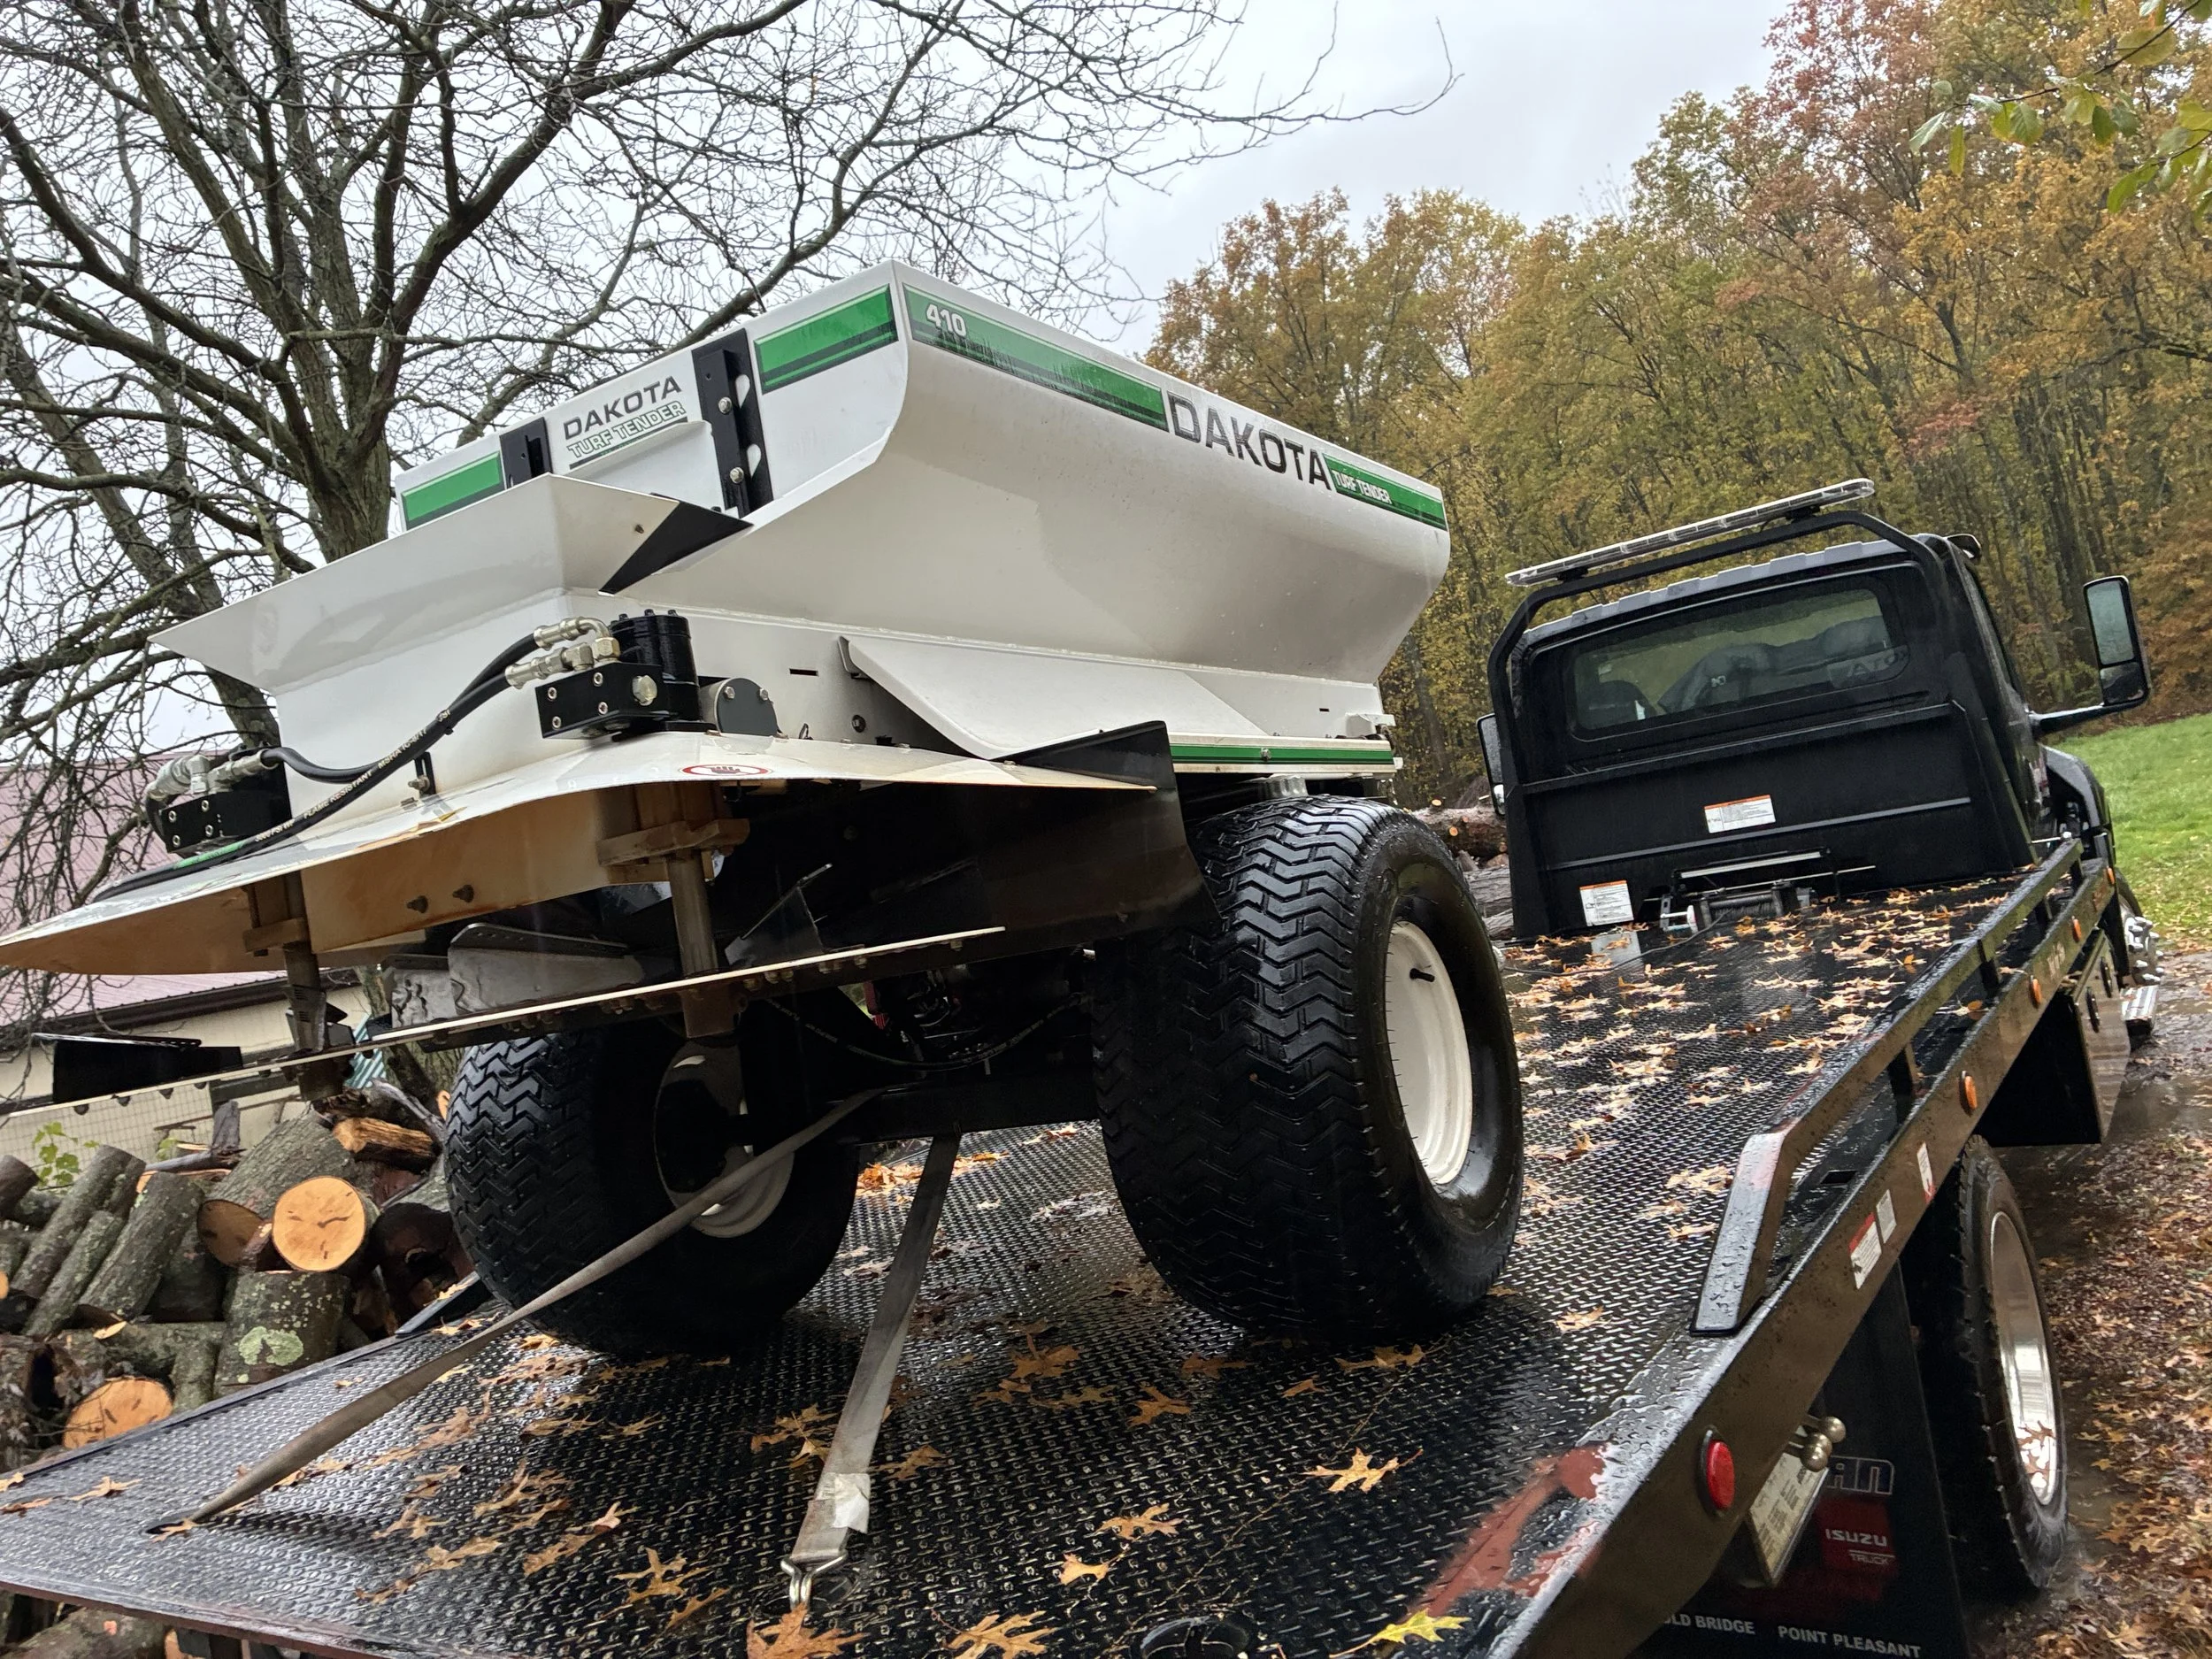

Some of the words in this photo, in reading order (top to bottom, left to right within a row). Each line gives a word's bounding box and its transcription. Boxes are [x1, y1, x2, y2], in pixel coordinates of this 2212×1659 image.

[926, 303, 966, 337] 410
[563, 375, 682, 441] DAKOTA
[566, 429, 613, 458] TURF
[611, 400, 687, 440] TENDER
[1167, 390, 1332, 491] DAKOTA
[1331, 470, 1356, 491] TURF
[1356, 479, 1393, 504] TENDER
[330, 771, 372, 803] RESISTANT
[1825, 1528, 1887, 1547] ISUZU
[1849, 1553, 1889, 1565] TRUCK
[1695, 1615, 1756, 1635] BRIDGE
[1778, 1625, 1827, 1645] POINT
[1833, 1633, 1921, 1658] PLEASANT
